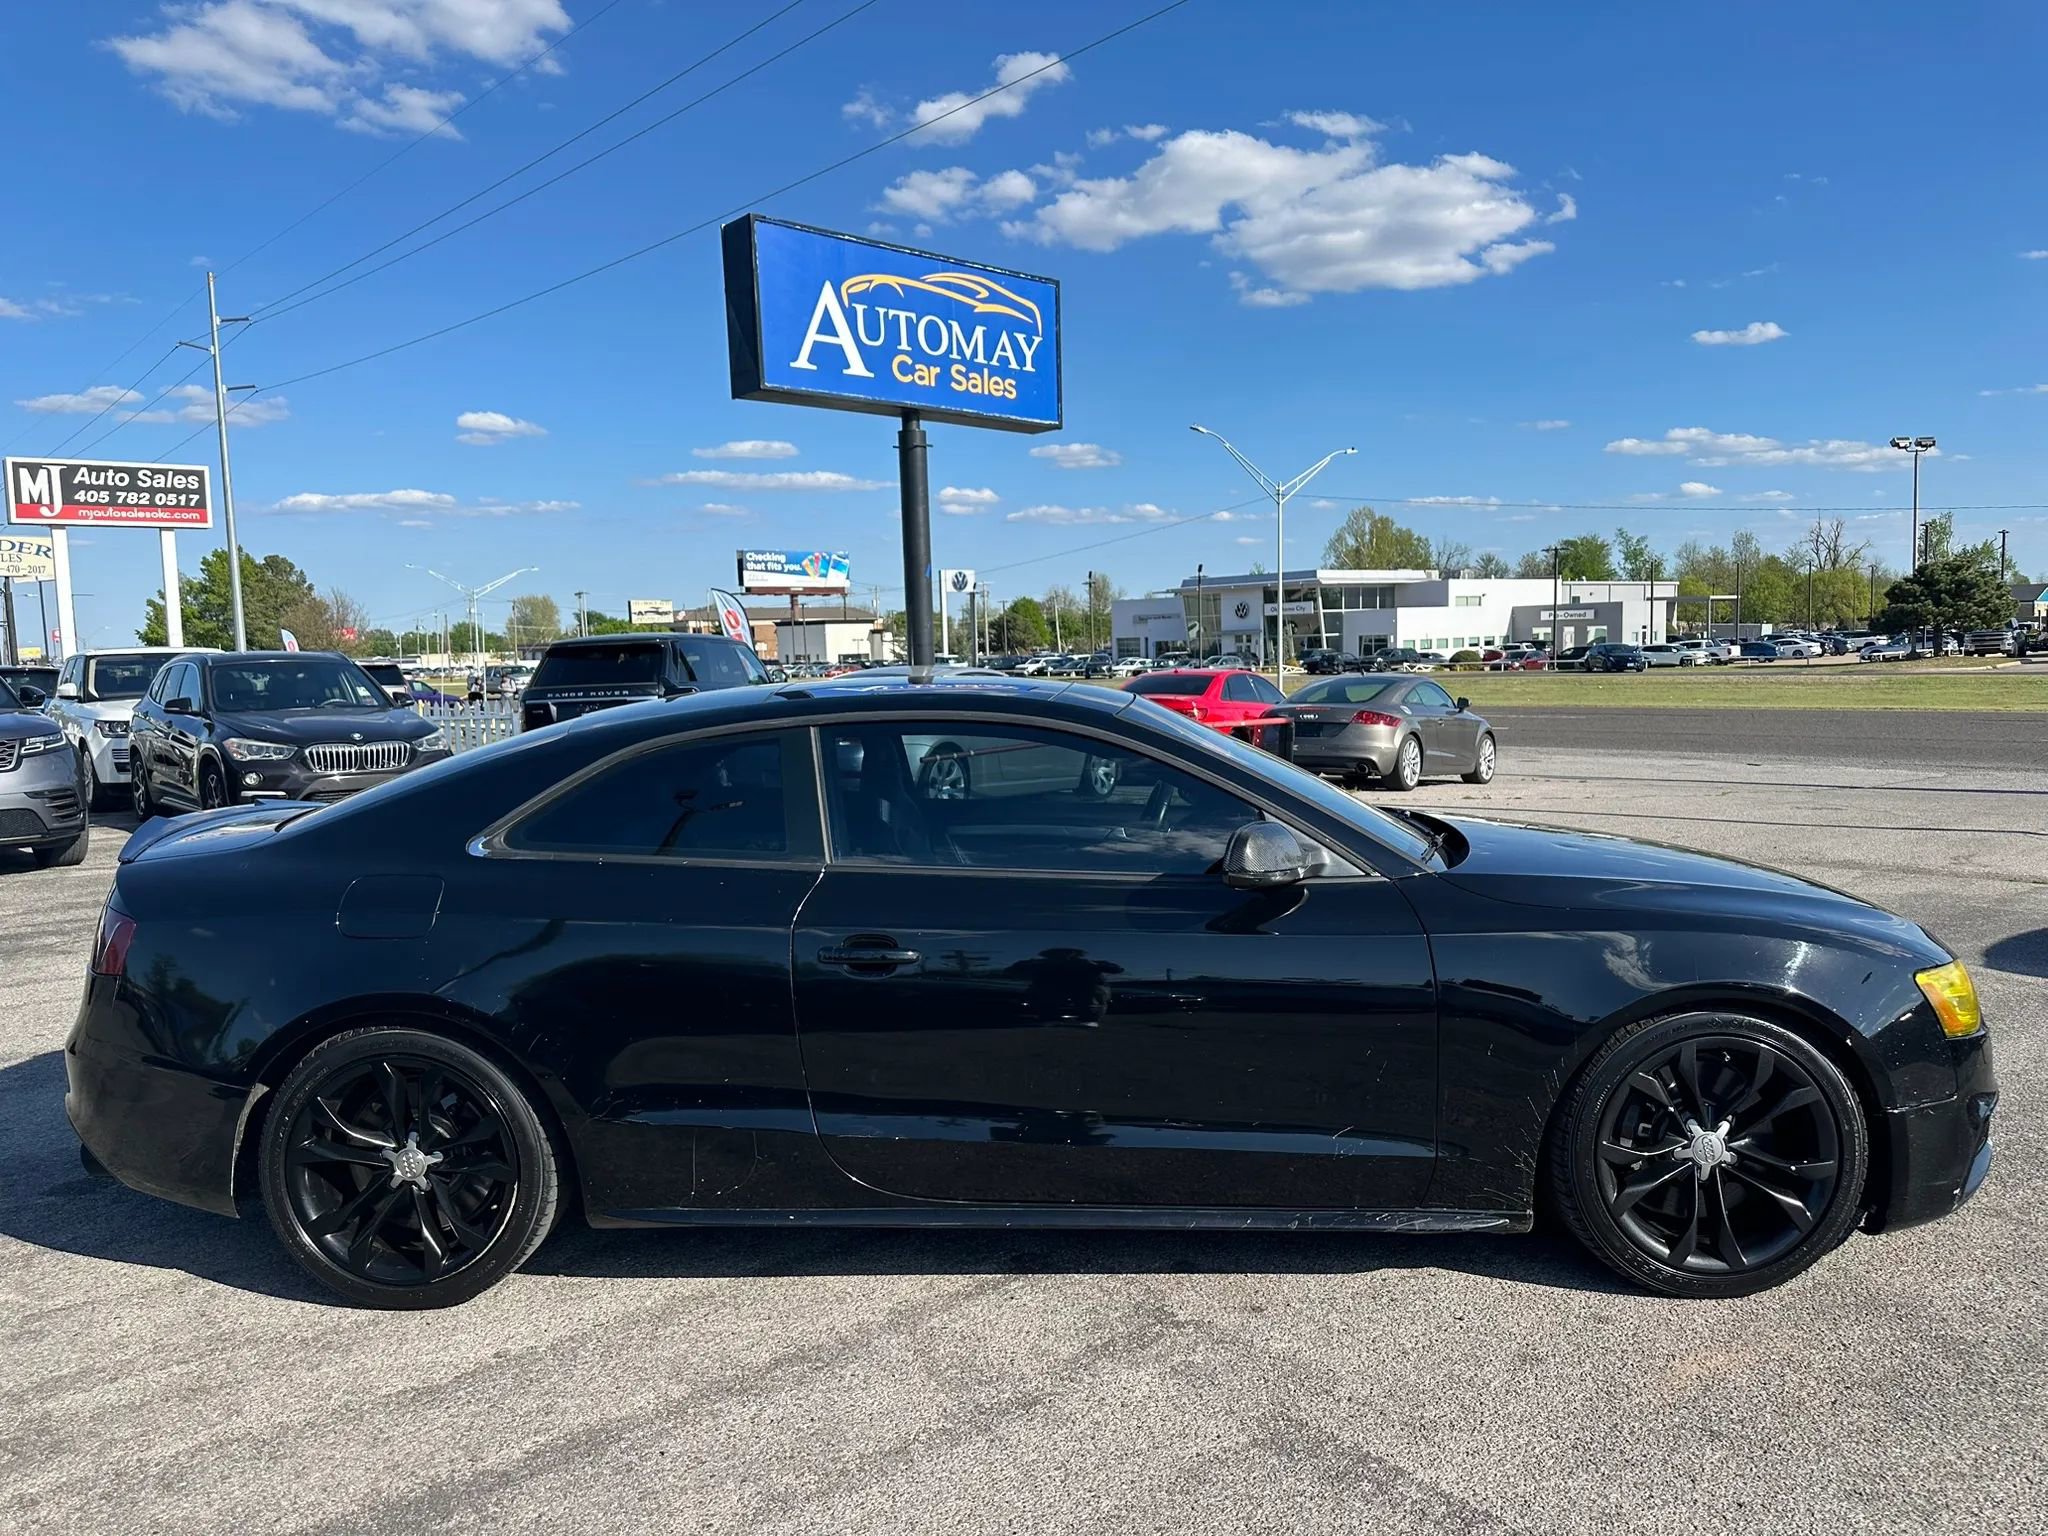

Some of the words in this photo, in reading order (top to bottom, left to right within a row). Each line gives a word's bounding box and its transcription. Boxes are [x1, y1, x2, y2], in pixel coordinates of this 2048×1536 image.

[789, 280, 1042, 378] AUTOMAY
[891, 354, 940, 387] Car
[950, 365, 1017, 399] Sales
[73, 467, 130, 487] Auto
[137, 469, 200, 489] Sales
[19, 465, 67, 517] MJ
[74, 490, 110, 503] 405
[116, 491, 150, 505] 782
[155, 493, 200, 507] 0517
[78, 508, 200, 520] mjautosalesokc.com
[746, 552, 786, 563] Checking
[746, 562, 765, 571] that
[767, 562, 782, 571] fits
[784, 563, 802, 572] you.
[1548, 611, 1587, 619] Pe-Owned
